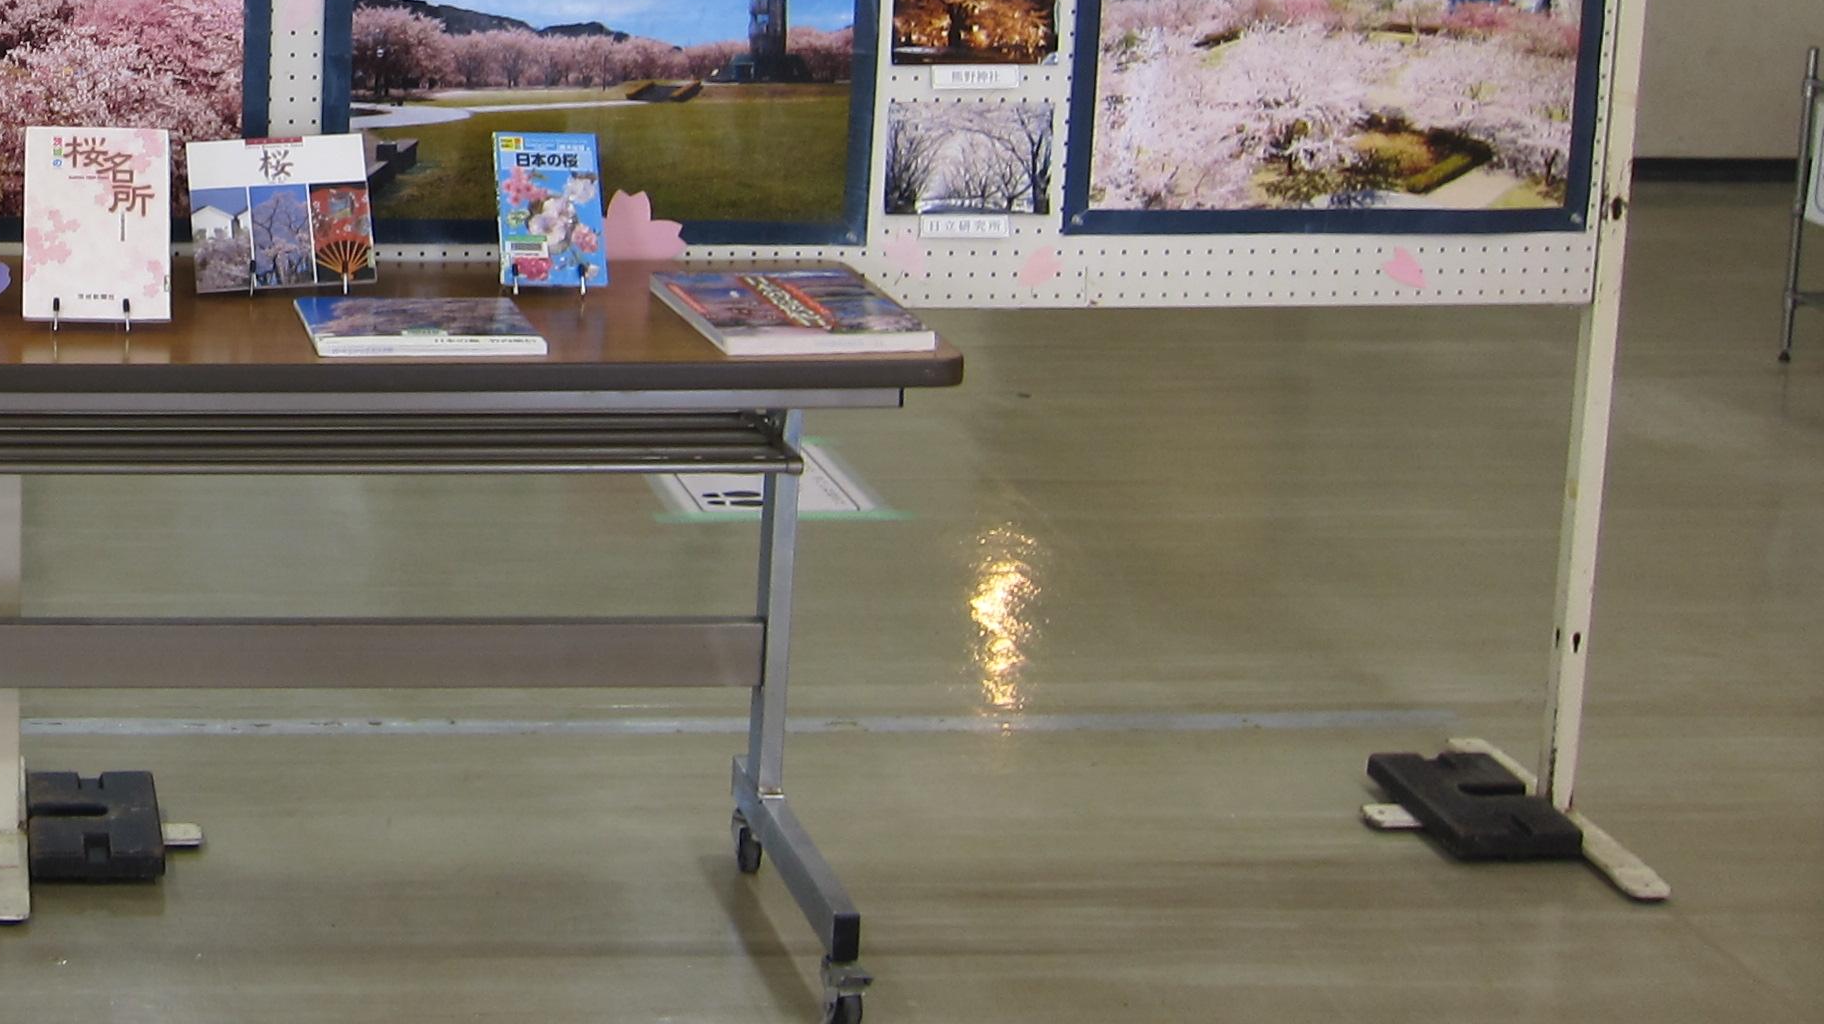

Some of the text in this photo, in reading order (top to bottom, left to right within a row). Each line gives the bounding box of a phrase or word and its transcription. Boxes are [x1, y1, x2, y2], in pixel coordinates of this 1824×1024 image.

[259, 149, 294, 178] 桜
[516, 152, 579, 168] 日本の桜
[63, 135, 155, 218] 桜名所
